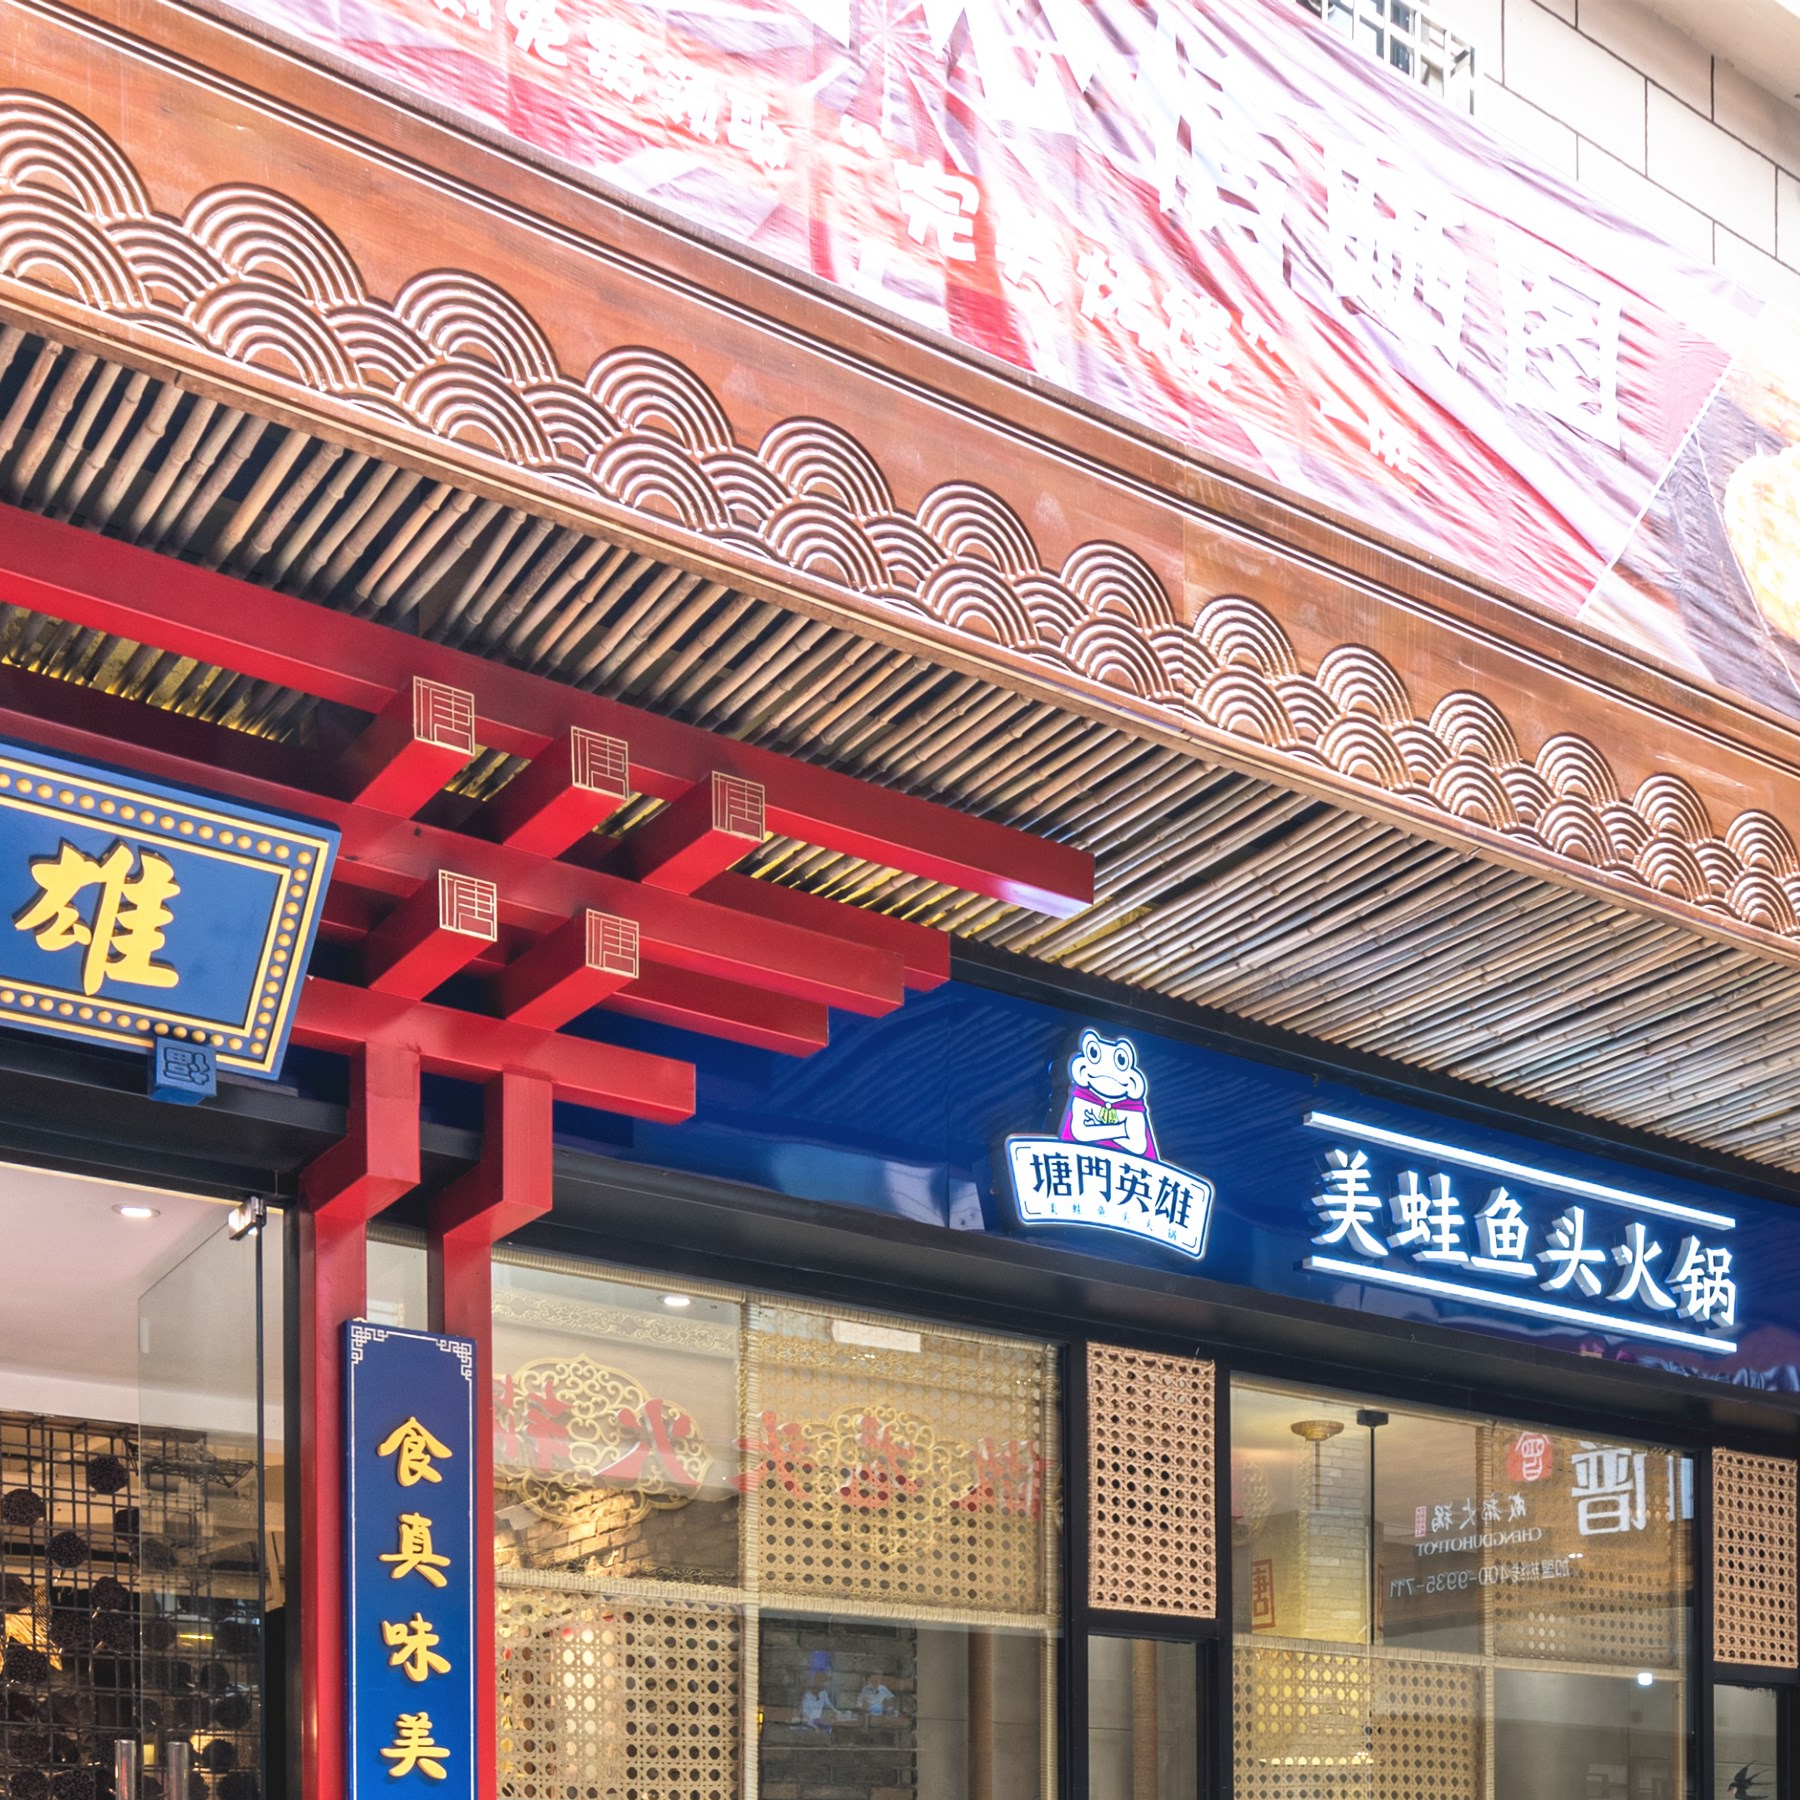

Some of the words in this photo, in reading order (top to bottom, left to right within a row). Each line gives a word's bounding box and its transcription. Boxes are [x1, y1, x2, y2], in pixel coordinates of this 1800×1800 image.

[1029, 1151, 1194, 1229] 塘門英雄
[1311, 1148, 1737, 1328] 美蛙鱼头火锅
